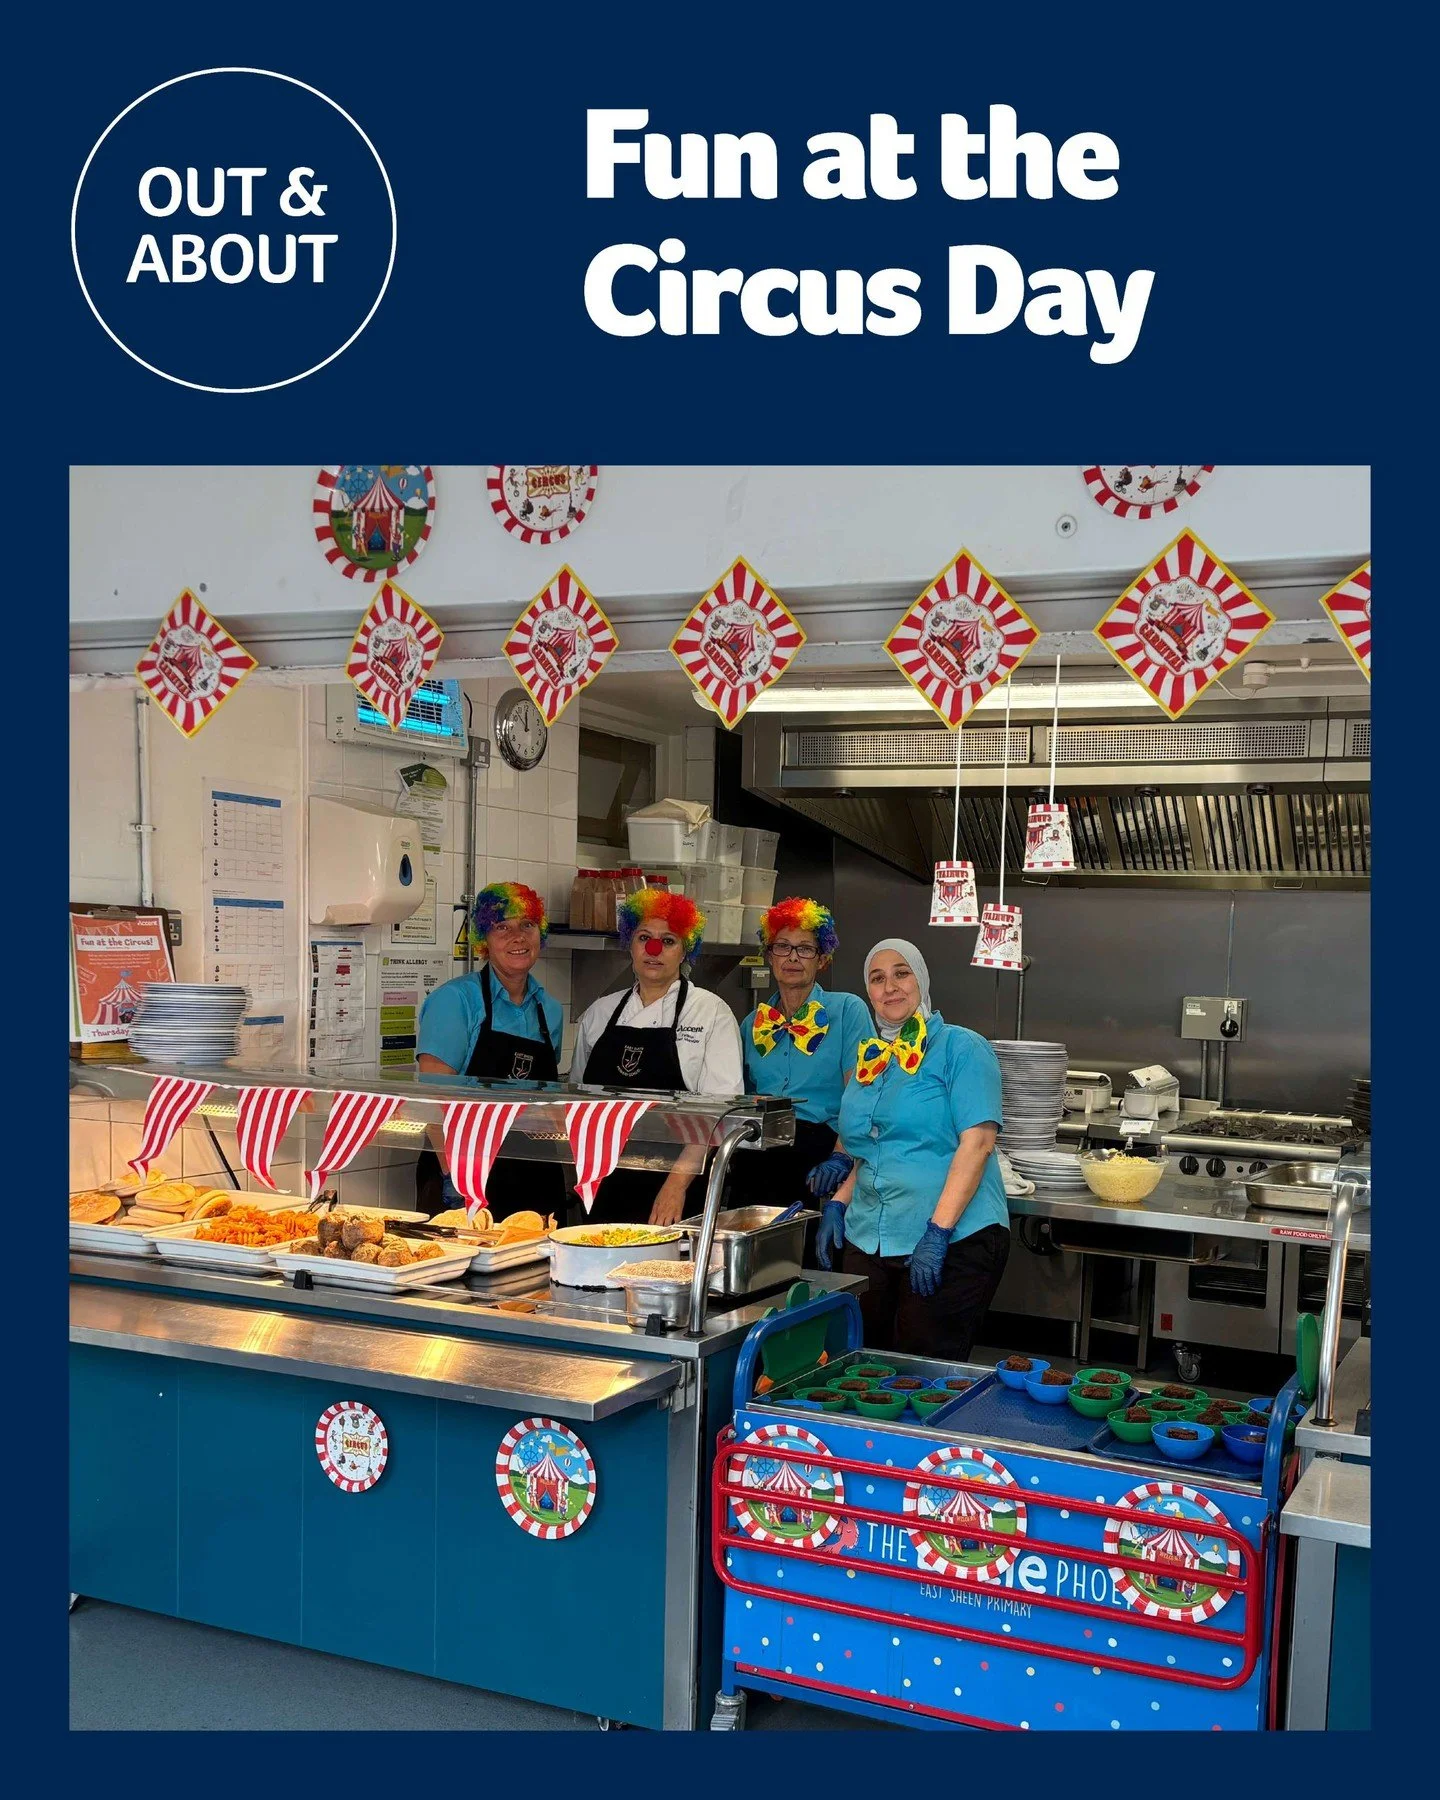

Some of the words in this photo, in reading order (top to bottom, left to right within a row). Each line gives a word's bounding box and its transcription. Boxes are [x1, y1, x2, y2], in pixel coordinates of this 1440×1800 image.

[531, 474, 566, 489] CIRCUS
[1140, 623, 1186, 672] CARNIVAL
[704, 641, 740, 685] CARNIVAL
[923, 639, 963, 685] CARNIVAL
[80, 938, 95, 946] Fun
[97, 938, 106, 946] at
[108, 937, 123, 946] the
[125, 937, 153, 946] Circus!
[91, 1028, 130, 1037] Thursday
[676, 1025, 704, 1033] Accent
[866, 1522, 908, 1562] THE
[987, 1595, 1033, 1619] PRIMARY
